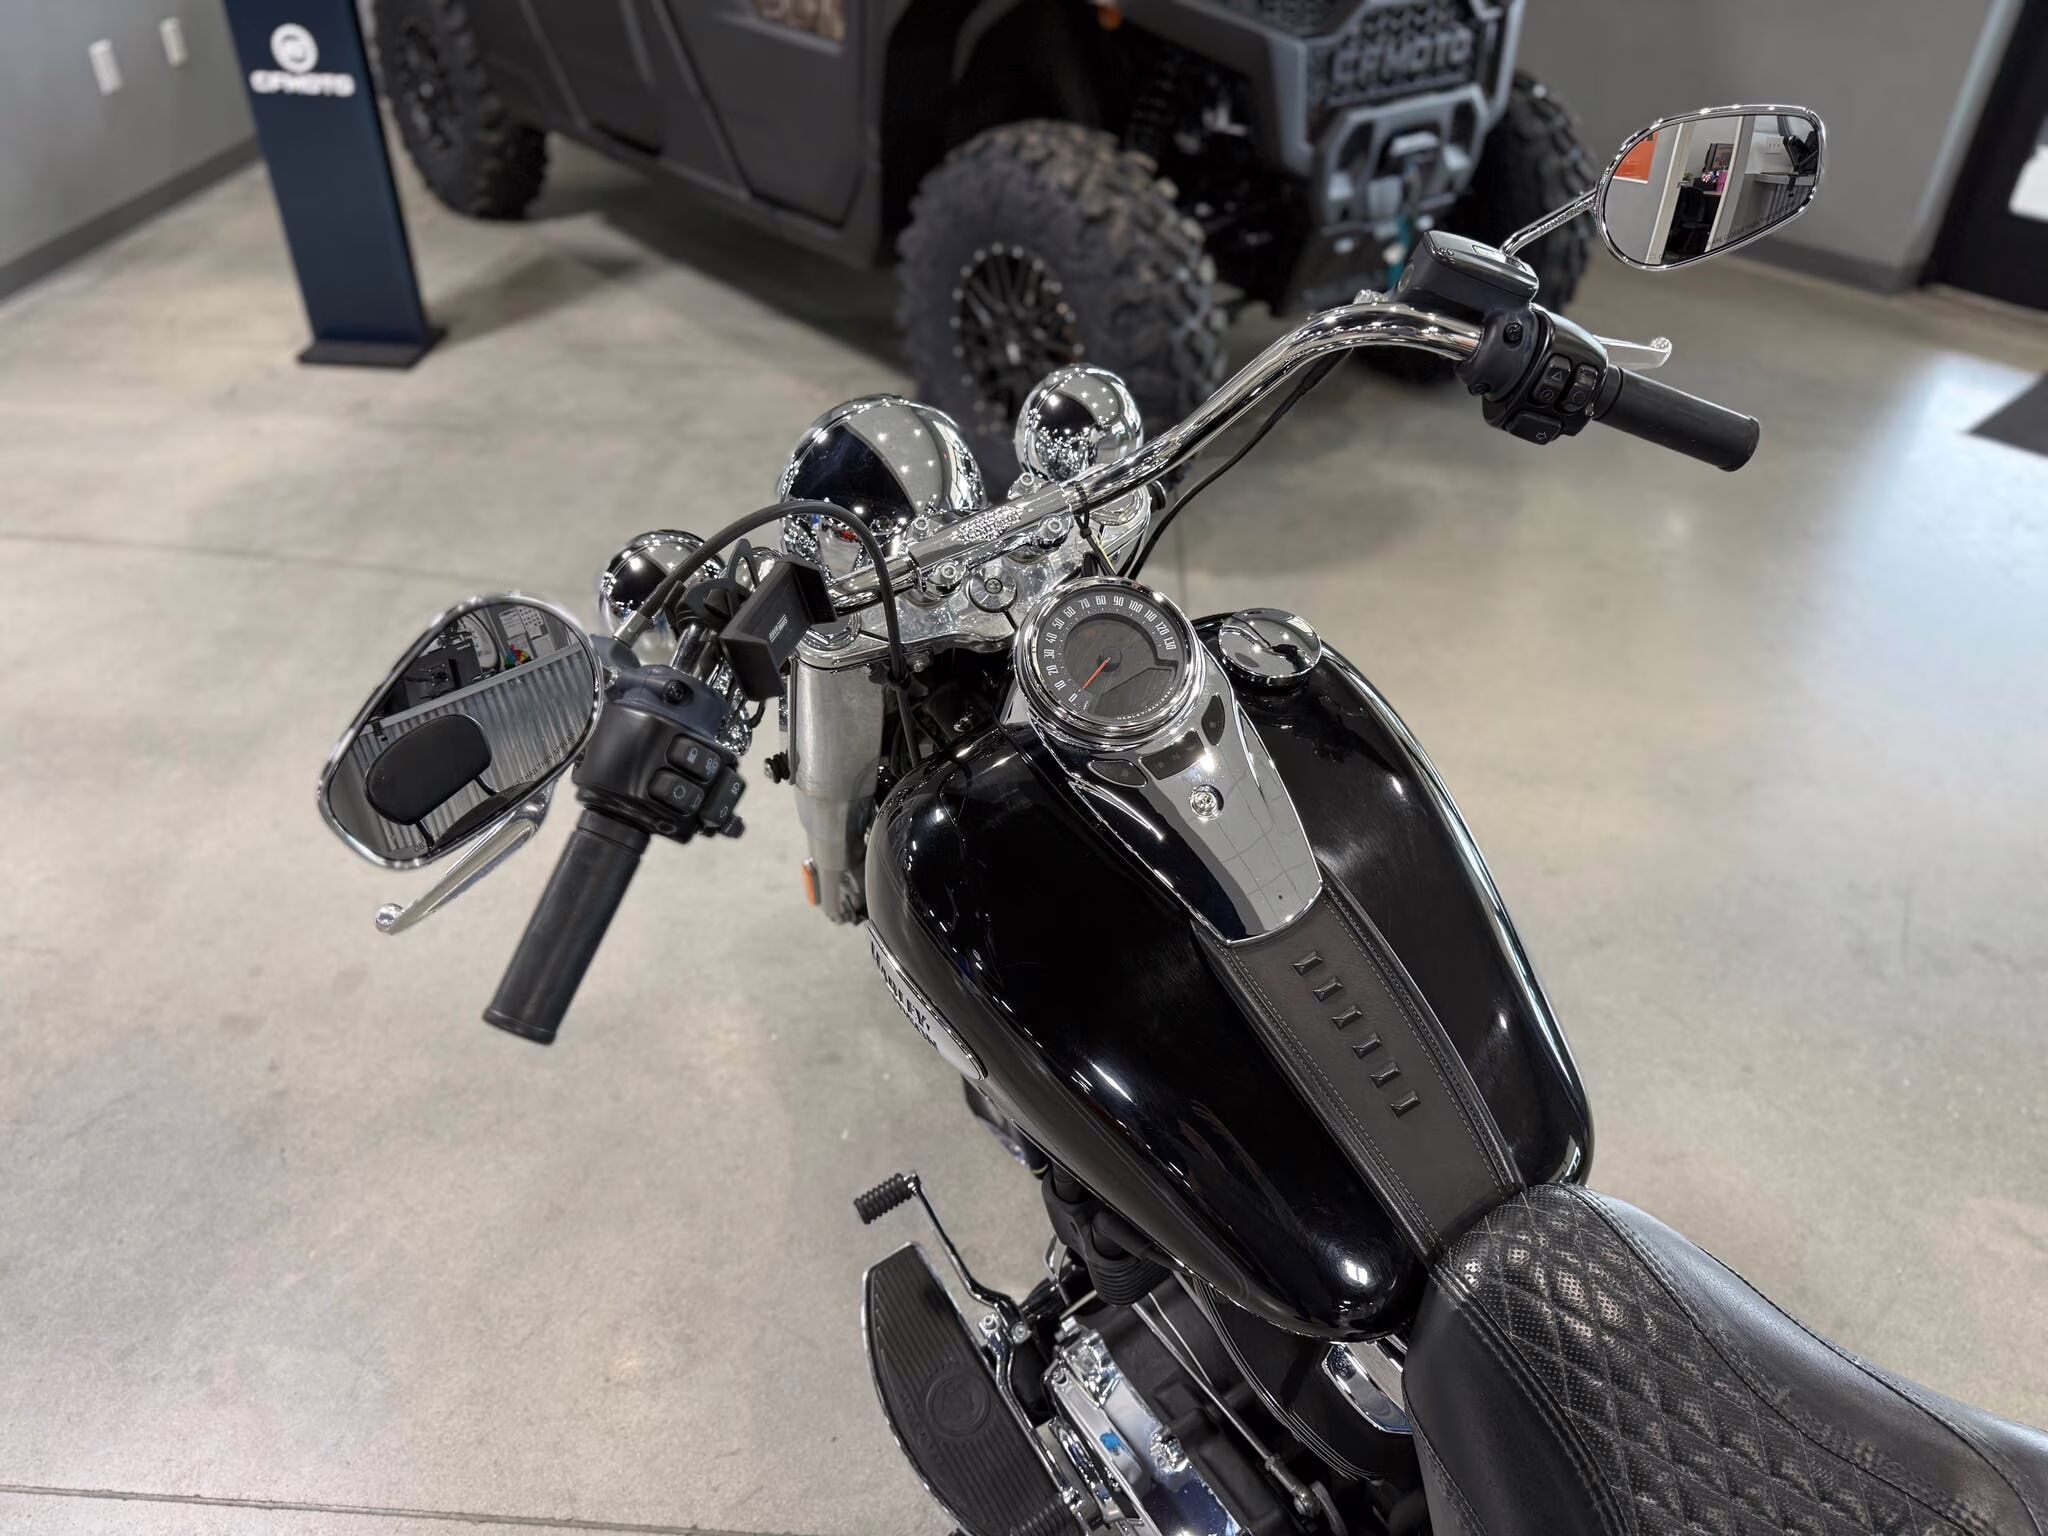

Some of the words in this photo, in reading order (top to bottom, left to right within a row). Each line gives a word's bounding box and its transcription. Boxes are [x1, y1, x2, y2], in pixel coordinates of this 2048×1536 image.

[1079, 598, 1091, 609] 70
[1095, 595, 1107, 605] 80
[1113, 596, 1125, 607] 90
[1063, 606, 1077, 618] 60
[1128, 600, 1144, 614] 100
[1144, 609, 1158, 622] 110
[1052, 617, 1065, 630] 50
[1154, 621, 1170, 636] 120
[1045, 632, 1058, 644] 40
[1163, 636, 1177, 651] 130
[1043, 648, 1055, 659] 30
[1046, 664, 1059, 676] 20
[1054, 680, 1067, 692] 10
[1068, 692, 1078, 703] 0
